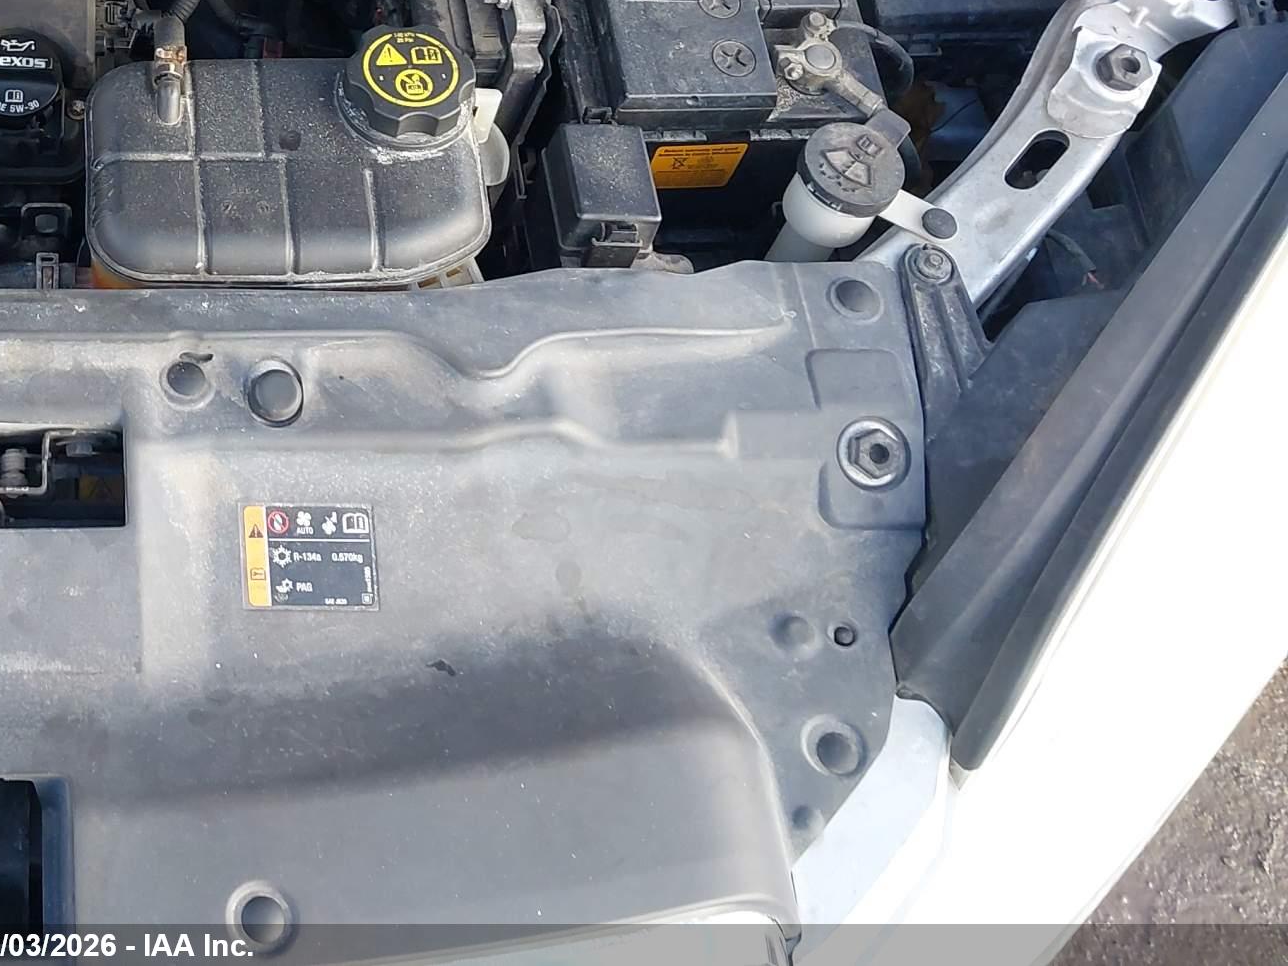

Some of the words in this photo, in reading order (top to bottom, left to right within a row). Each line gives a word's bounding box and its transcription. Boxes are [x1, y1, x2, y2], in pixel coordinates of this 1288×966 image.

[9, 99, 40, 113] 5W-30
[296, 527, 314, 535] AUTO
[293, 552, 322, 562] R-134a
[296, 582, 313, 592] PAG
